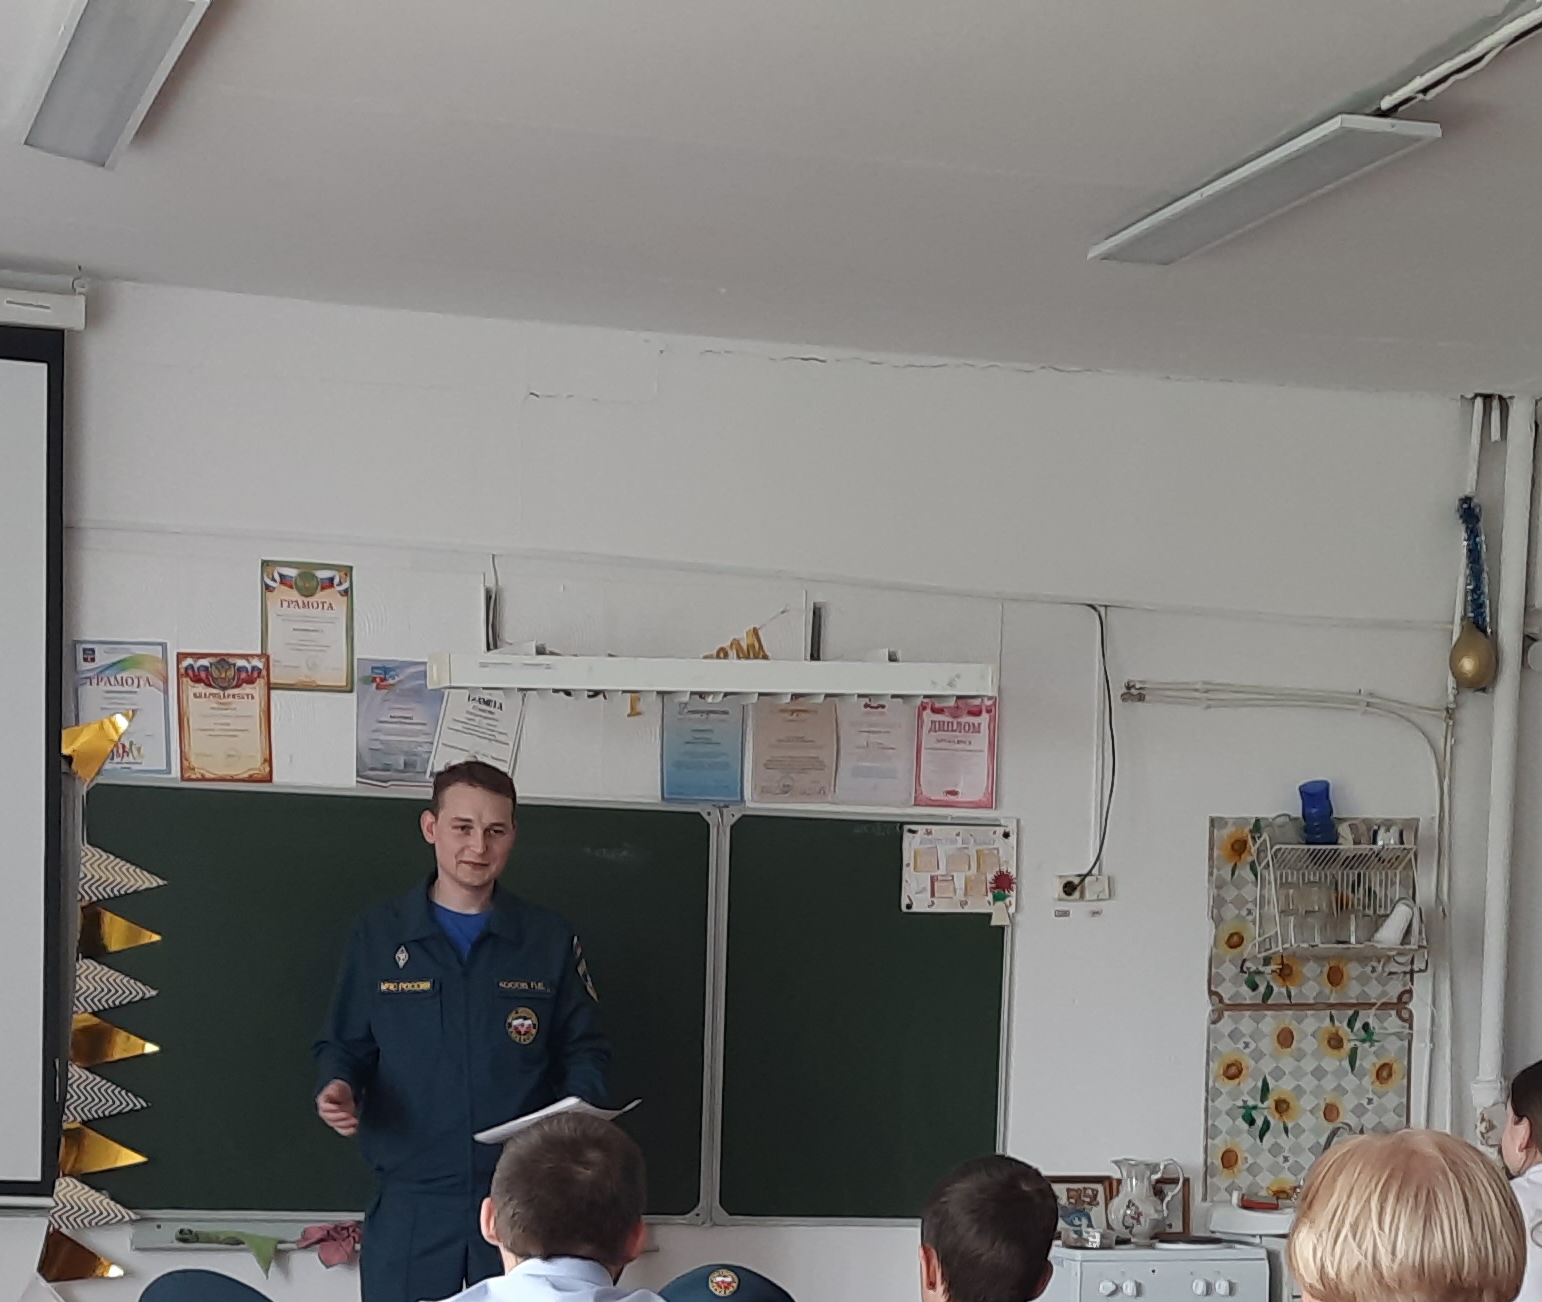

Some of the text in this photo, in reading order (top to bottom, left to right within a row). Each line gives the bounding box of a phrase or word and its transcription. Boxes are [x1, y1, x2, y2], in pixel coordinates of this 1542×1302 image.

[280, 599, 335, 611] ГРАМОТА
[87, 675, 153, 688] ГРАМОТА
[928, 720, 982, 733] ДИПЛОМ
